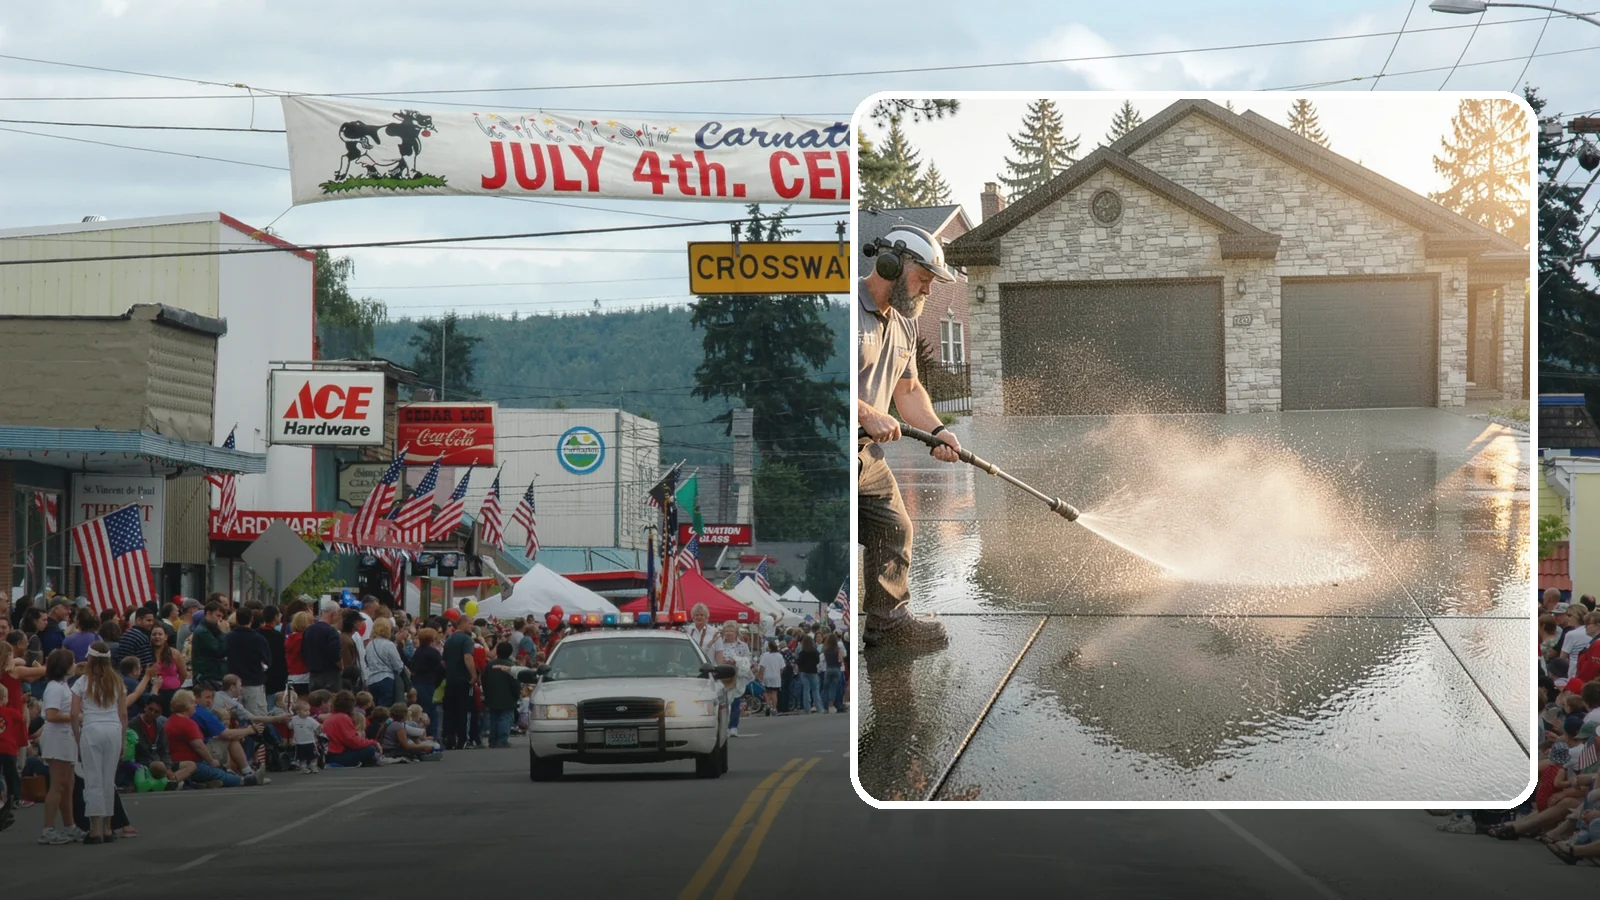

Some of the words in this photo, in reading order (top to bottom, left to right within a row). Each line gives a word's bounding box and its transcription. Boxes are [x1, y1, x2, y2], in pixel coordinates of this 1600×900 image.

[695, 121, 850, 150] Carnat
[481, 140, 605, 193] JULY
[632, 149, 746, 198] 4th.
[697, 254, 850, 280] CROSSWA
[282, 380, 374, 420] ACE
[405, 409, 453, 422] CEDAR
[283, 421, 371, 436] Hardware
[416, 428, 477, 447] Coca-Cola
[95, 485, 124, 495] Vincent
[126, 485, 136, 495] de
[137, 486, 155, 495] Paul
[688, 526, 741, 535] CRNATION
[699, 535, 730, 543] GLASS
